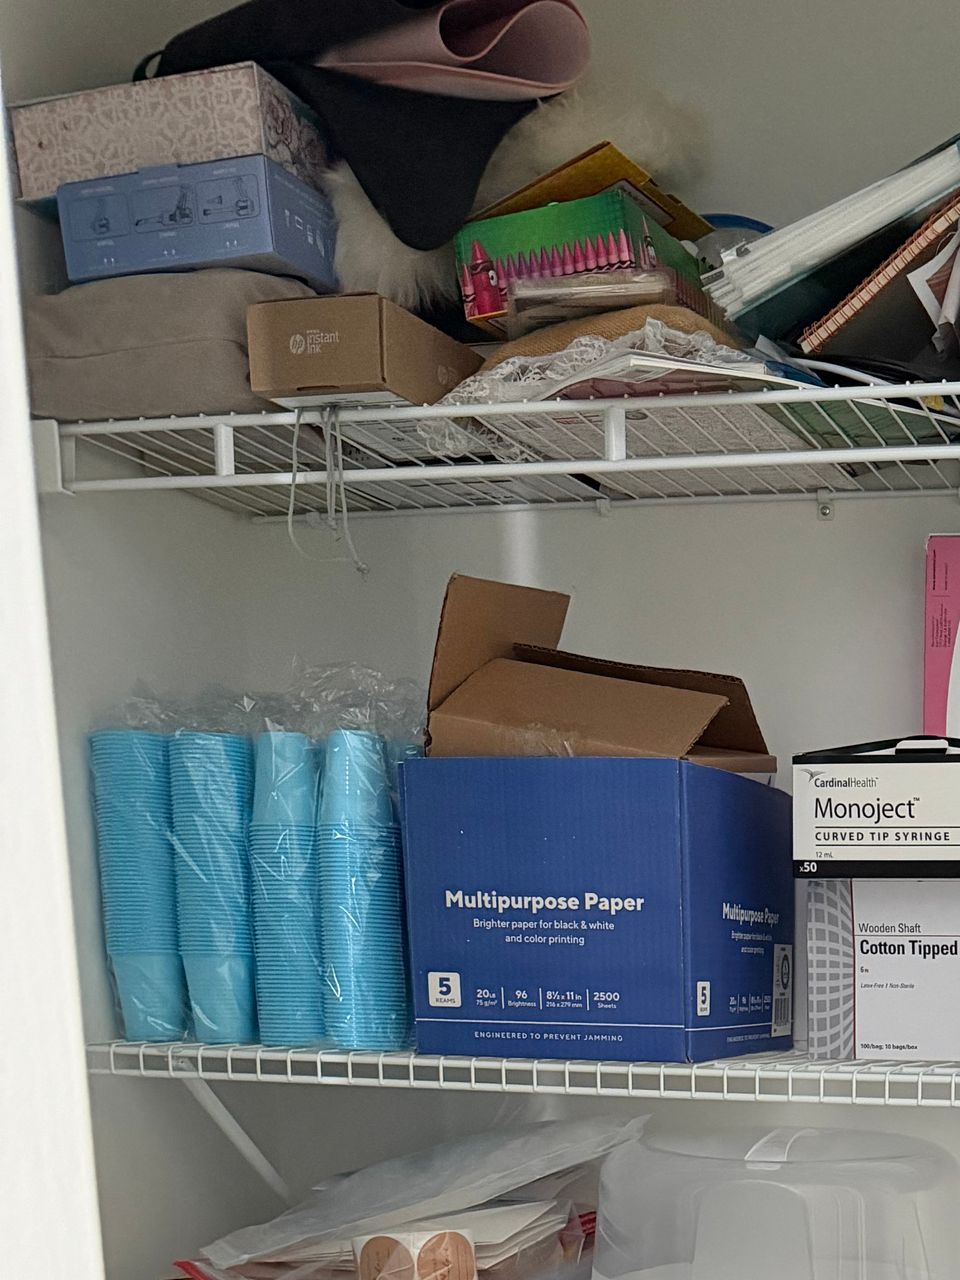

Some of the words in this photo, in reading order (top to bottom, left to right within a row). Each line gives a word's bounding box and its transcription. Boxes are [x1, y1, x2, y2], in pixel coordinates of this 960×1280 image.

[815, 832, 864, 841] CURVED
[870, 832, 890, 841] TIP
[895, 831, 951, 841] SYRINGE
[815, 851, 823, 859] 12
[799, 861, 818, 873] x50
[445, 890, 580, 914] Multipurpose
[584, 892, 645, 915] Paper
[722, 902, 764, 926] Multipurpose
[764, 908, 780, 928] Paper
[473, 918, 510, 930] Brighter
[511, 920, 537, 930] paper
[539, 919, 552, 929] for
[554, 919, 579, 930] black
[580, 920, 588, 930] &
[589, 920, 615, 930] white
[858, 923, 896, 934] Wooden
[898, 923, 921, 934] Shaft
[505, 934, 522, 943] and
[524, 934, 547, 943] color
[549, 935, 585, 945] printing
[860, 939, 905, 955] Cotton
[909, 940, 958, 959] Tipped
[439, 977, 452, 996] 5
[515, 990, 528, 999] 96
[566, 991, 574, 1000] 11
[593, 991, 620, 1001] 2500
[701, 986, 707, 1005] 5
[508, 1000, 537, 1008] Brightness
[597, 1002, 617, 1010] Sheets
[474, 1031, 528, 1039] ENGINEERED
[530, 1032, 541, 1040] TO
[543, 1033, 582, 1041] PREVENT
[584, 1034, 623, 1042] JAMMING
